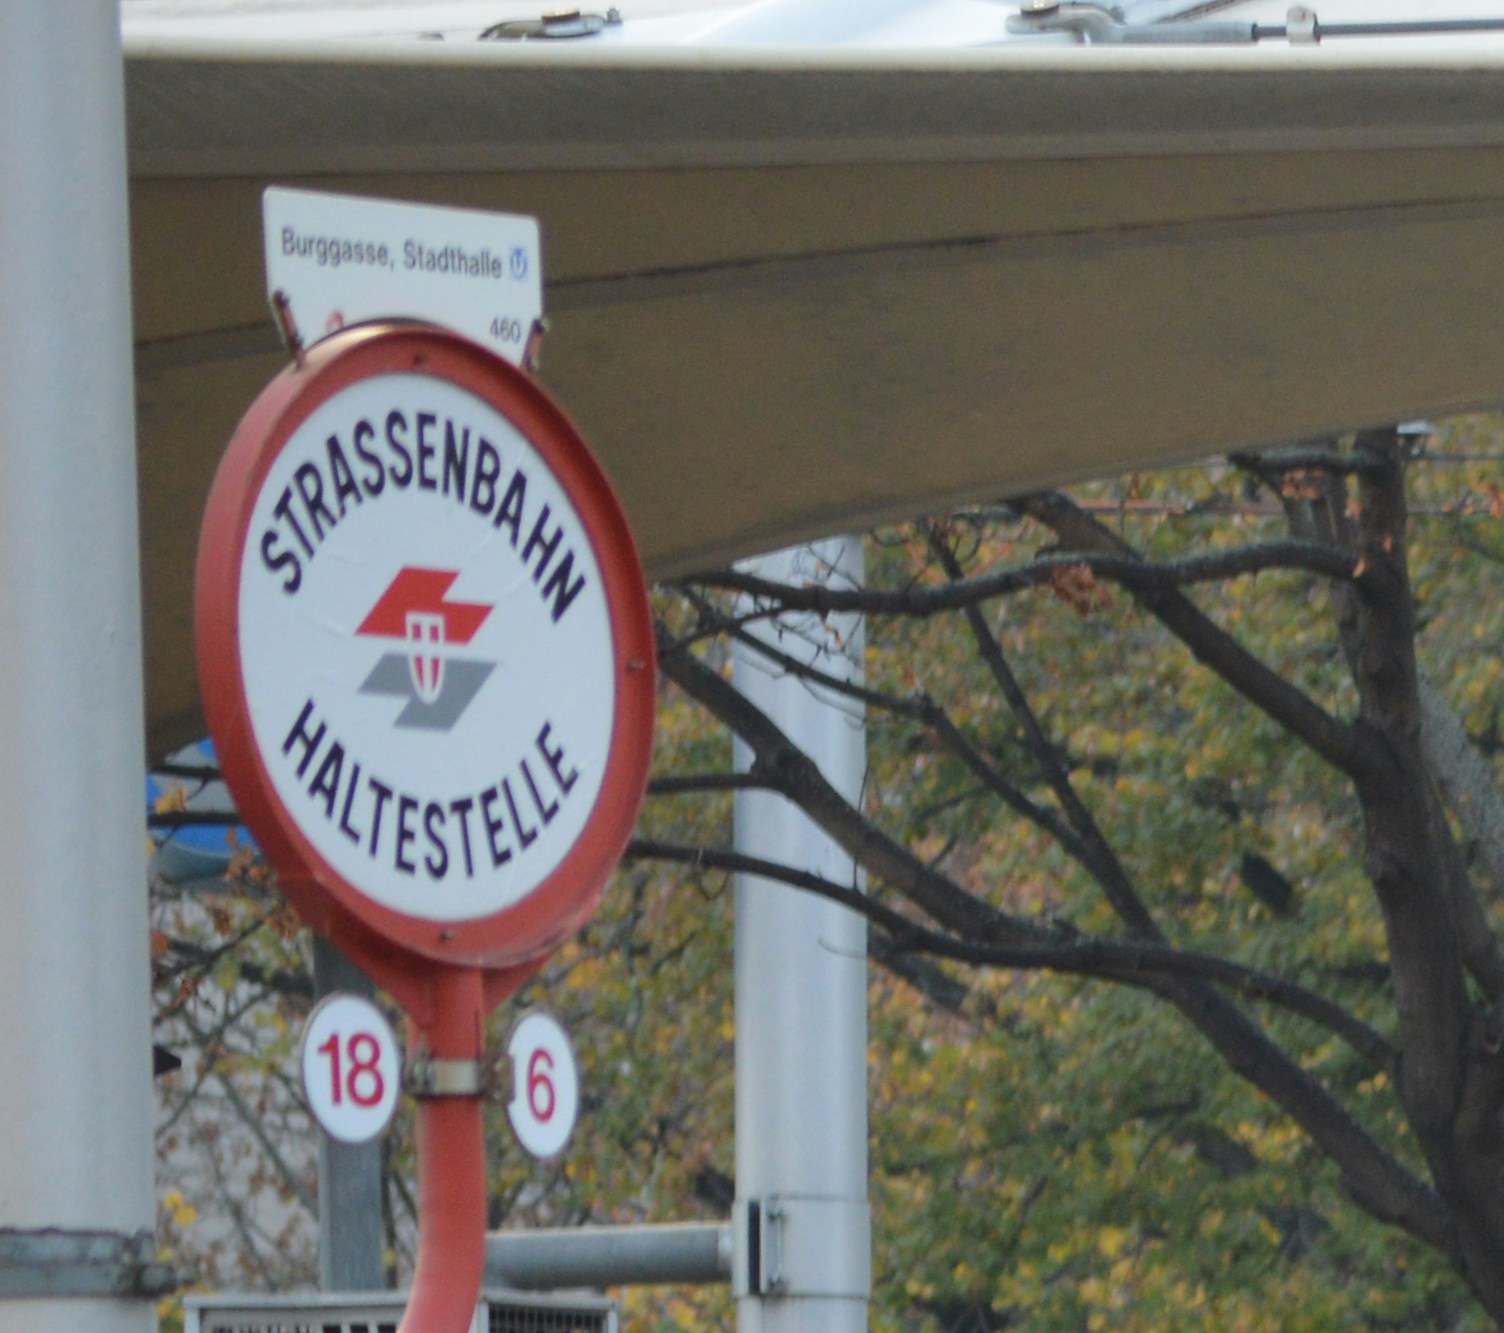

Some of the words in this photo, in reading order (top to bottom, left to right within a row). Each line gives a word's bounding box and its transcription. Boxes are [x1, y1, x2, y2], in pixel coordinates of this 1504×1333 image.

[282, 227, 395, 272] Burggasse,
[403, 239, 502, 279] Stadthalle
[489, 318, 521, 344] 460
[260, 409, 586, 625] STRASSENBAHN
[281, 697, 580, 880] HALTESTELLE
[318, 1033, 384, 1108] 18
[527, 1047, 555, 1122] 6
